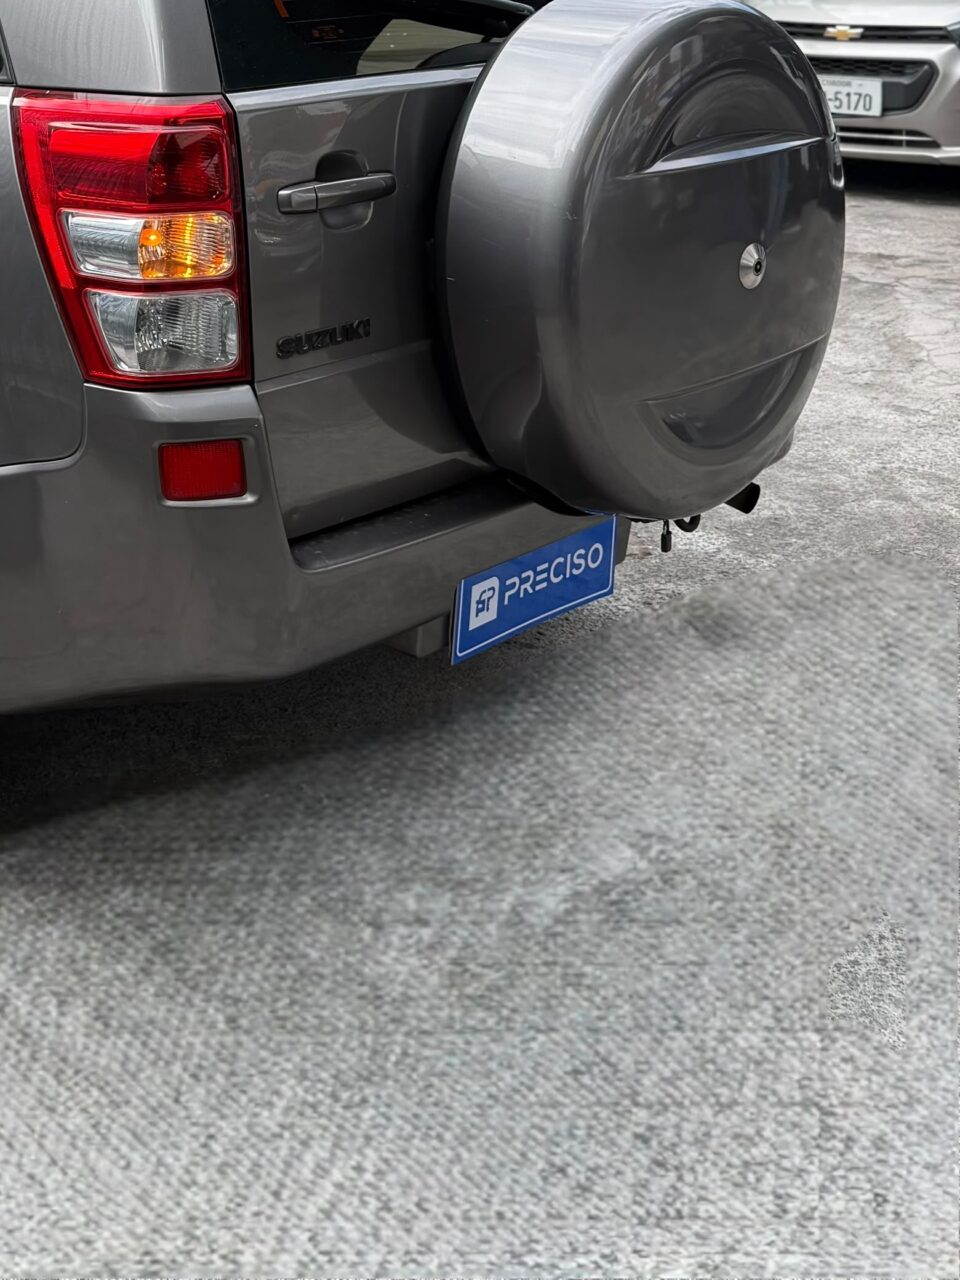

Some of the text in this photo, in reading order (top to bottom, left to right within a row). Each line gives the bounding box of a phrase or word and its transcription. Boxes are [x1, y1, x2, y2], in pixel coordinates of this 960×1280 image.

[826, 91, 873, 112] -5170
[276, 318, 371, 360] SUZUKI
[503, 542, 604, 606] PRECISO
